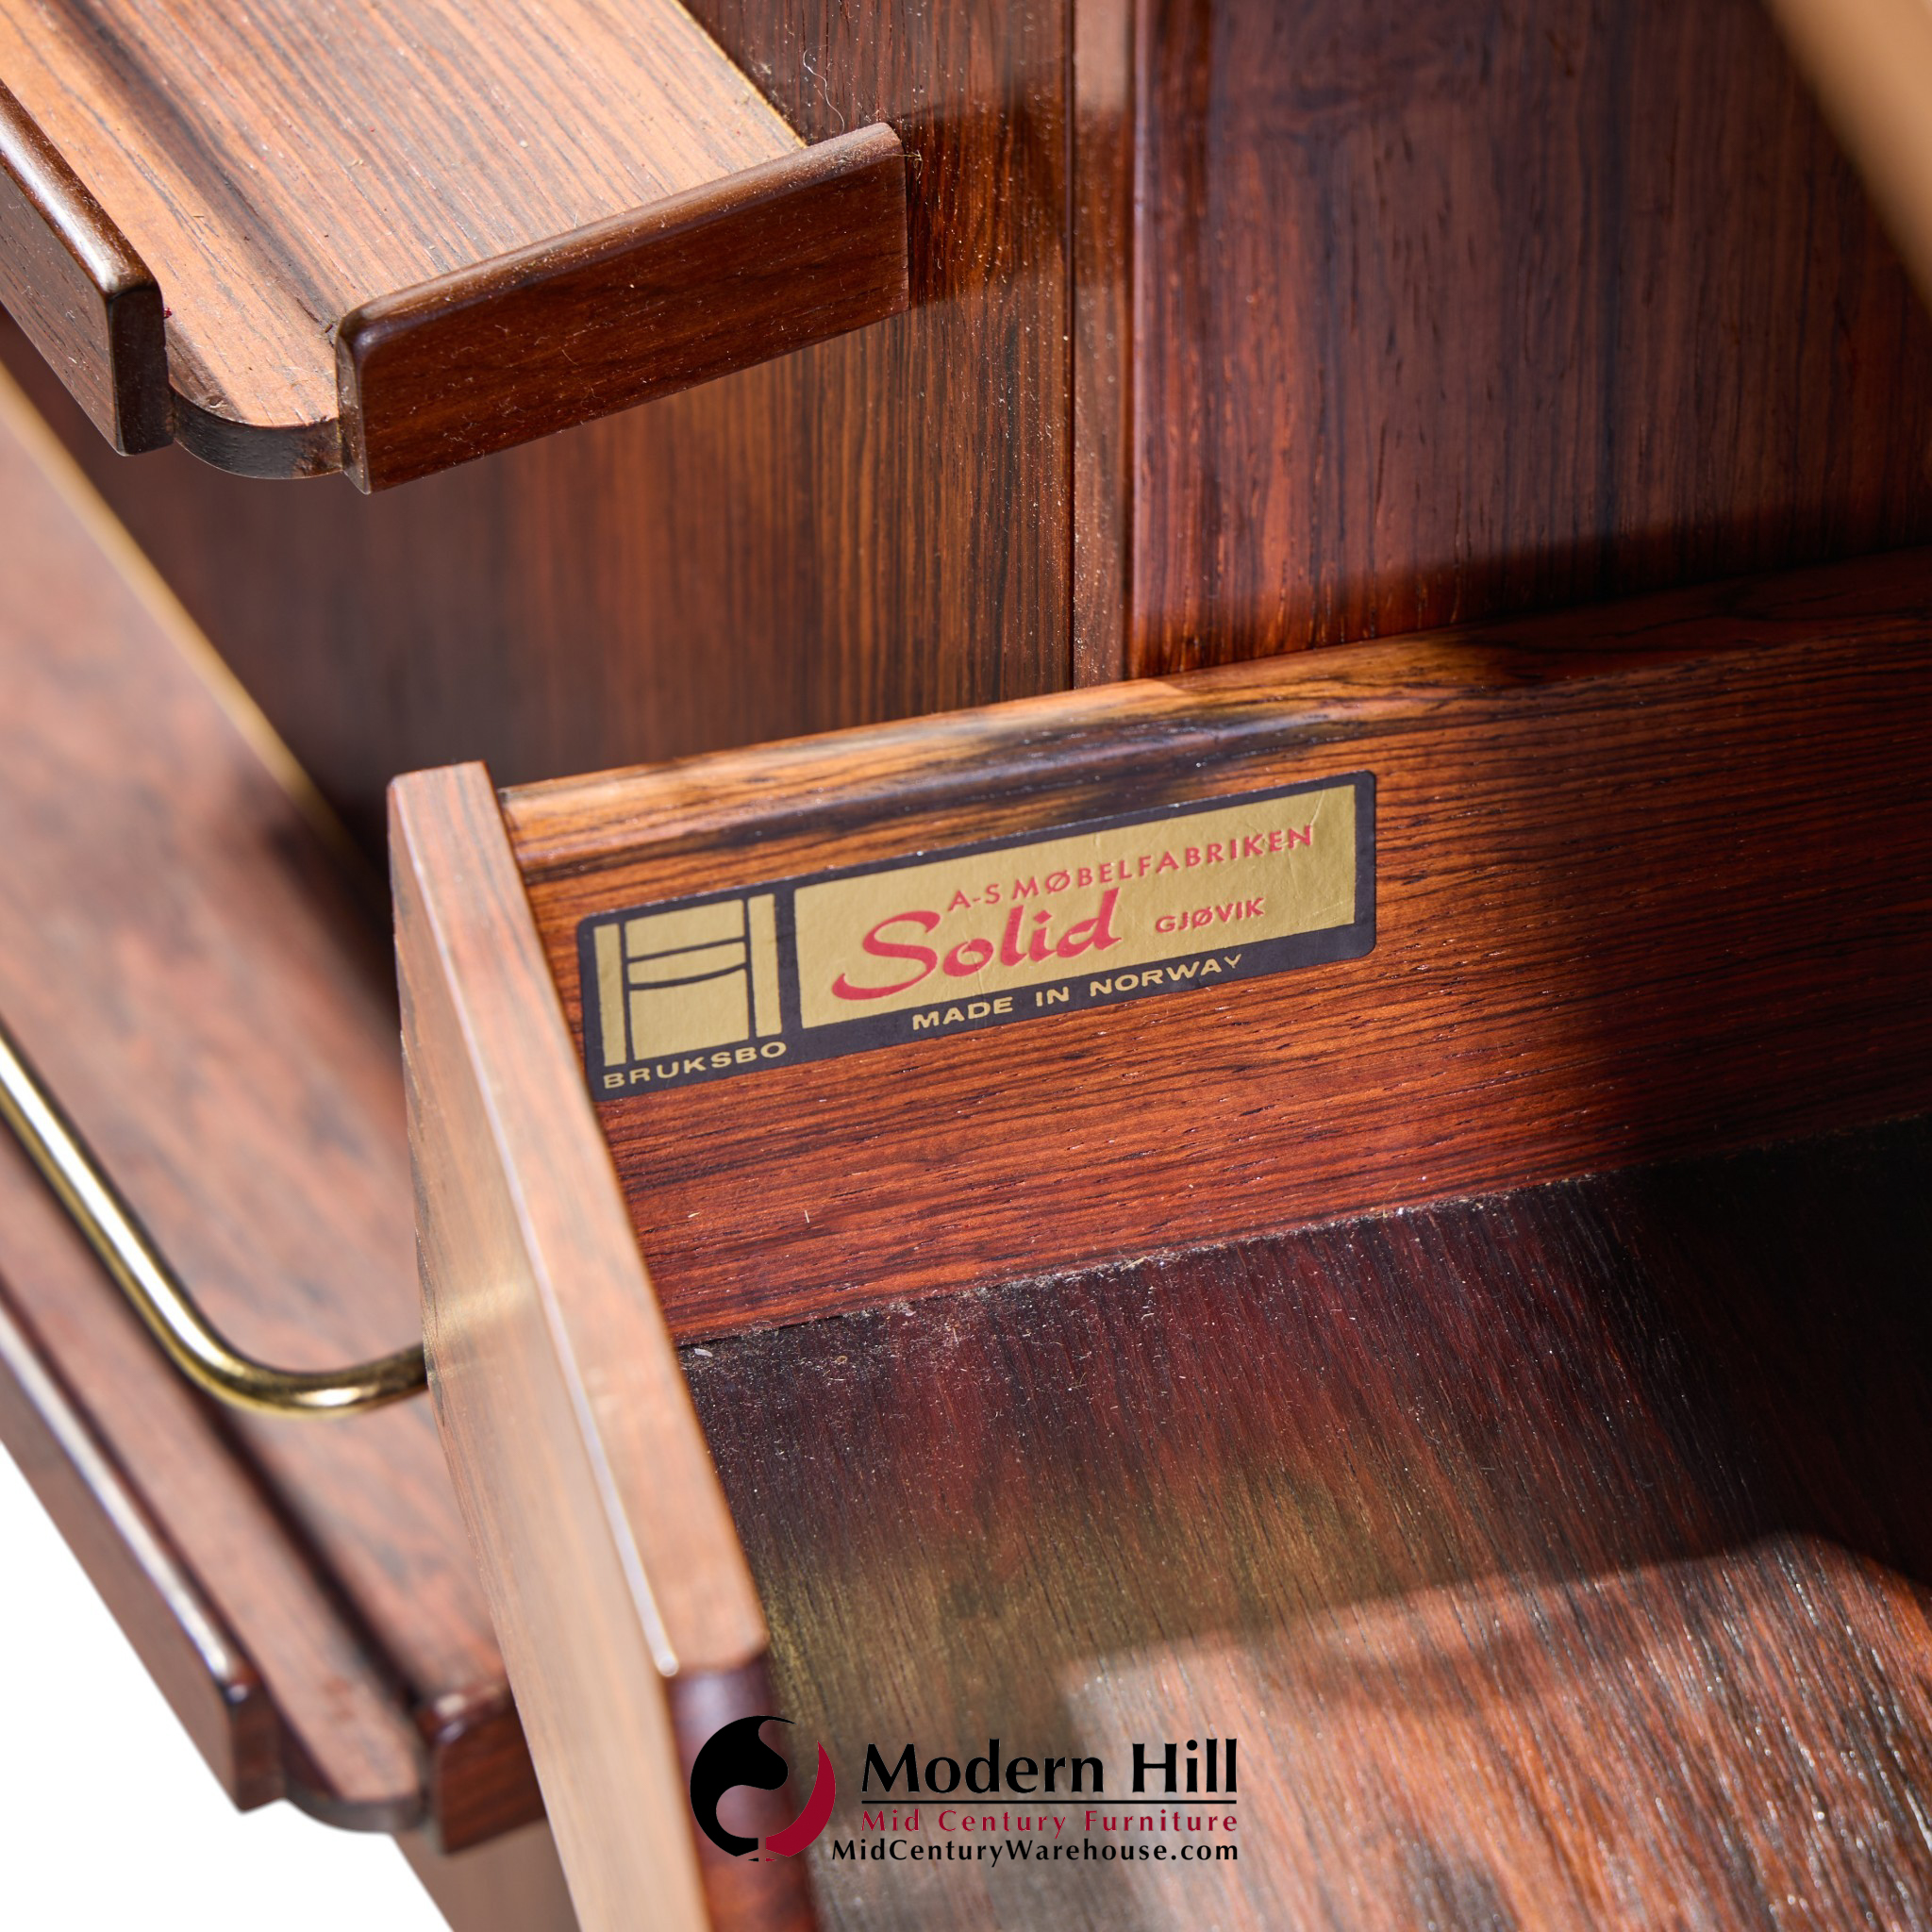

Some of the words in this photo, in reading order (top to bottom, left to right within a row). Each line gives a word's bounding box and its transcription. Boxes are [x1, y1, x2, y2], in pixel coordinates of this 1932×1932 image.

[1012, 824, 1315, 900] MØBELFABRIKEN
[831, 889, 1123, 1001] Solid
[1154, 897, 1265, 935] GJØVIK
[910, 996, 1013, 1031] MADE
[1035, 984, 1072, 1008] IN
[1089, 954, 1243, 999] NORWAY
[603, 1041, 789, 1091] BRUKSBO
